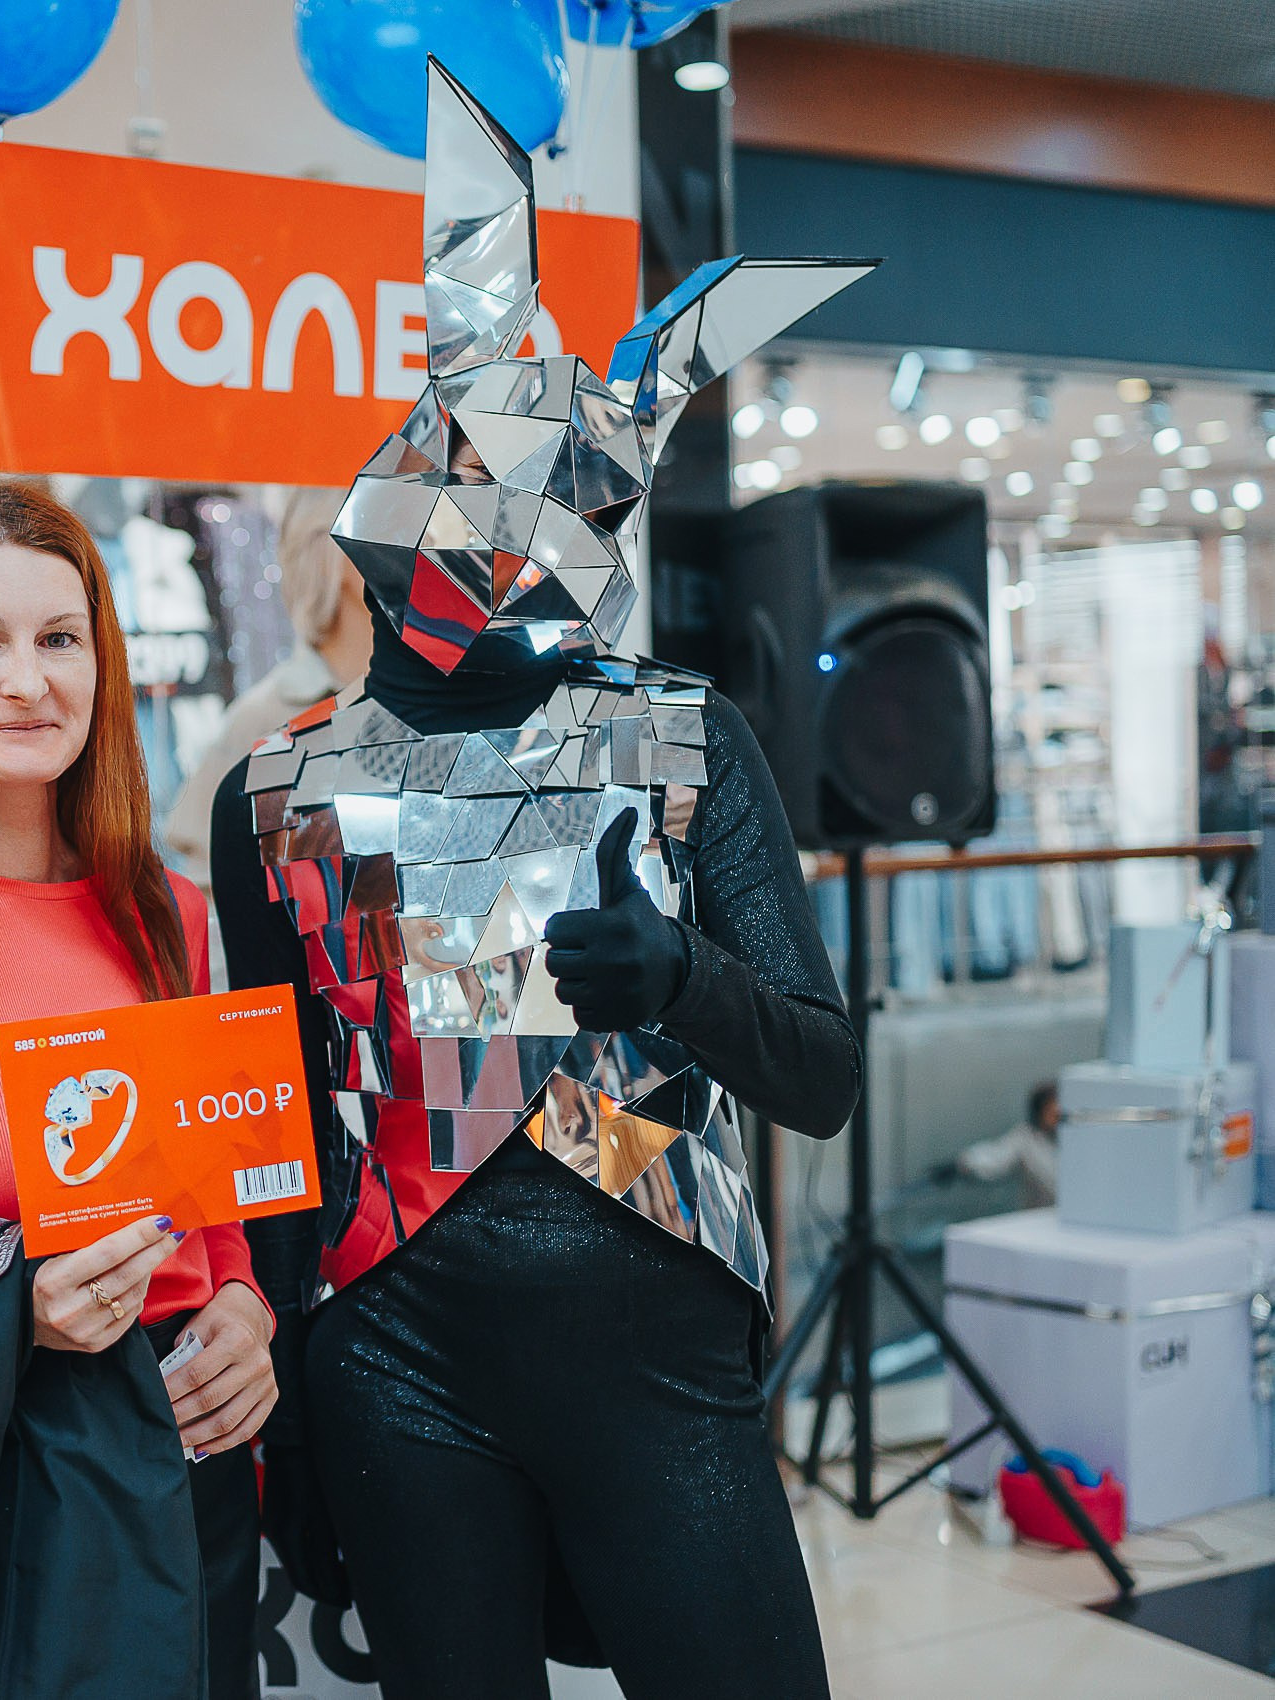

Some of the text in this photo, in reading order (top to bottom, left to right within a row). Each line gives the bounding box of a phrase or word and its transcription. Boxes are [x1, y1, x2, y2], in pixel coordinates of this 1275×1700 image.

[219, 1005, 283, 1022] СЕРТИФИКАТ
[14, 1027, 106, 1052] 585 ЗОЛОТОЙ
[38, 1197, 153, 1222] Данным сертификатом может быть
[39, 1218, 68, 1228] оплачен
[68, 1215, 89, 1223] товар
[99, 1210, 120, 1218] сумму
